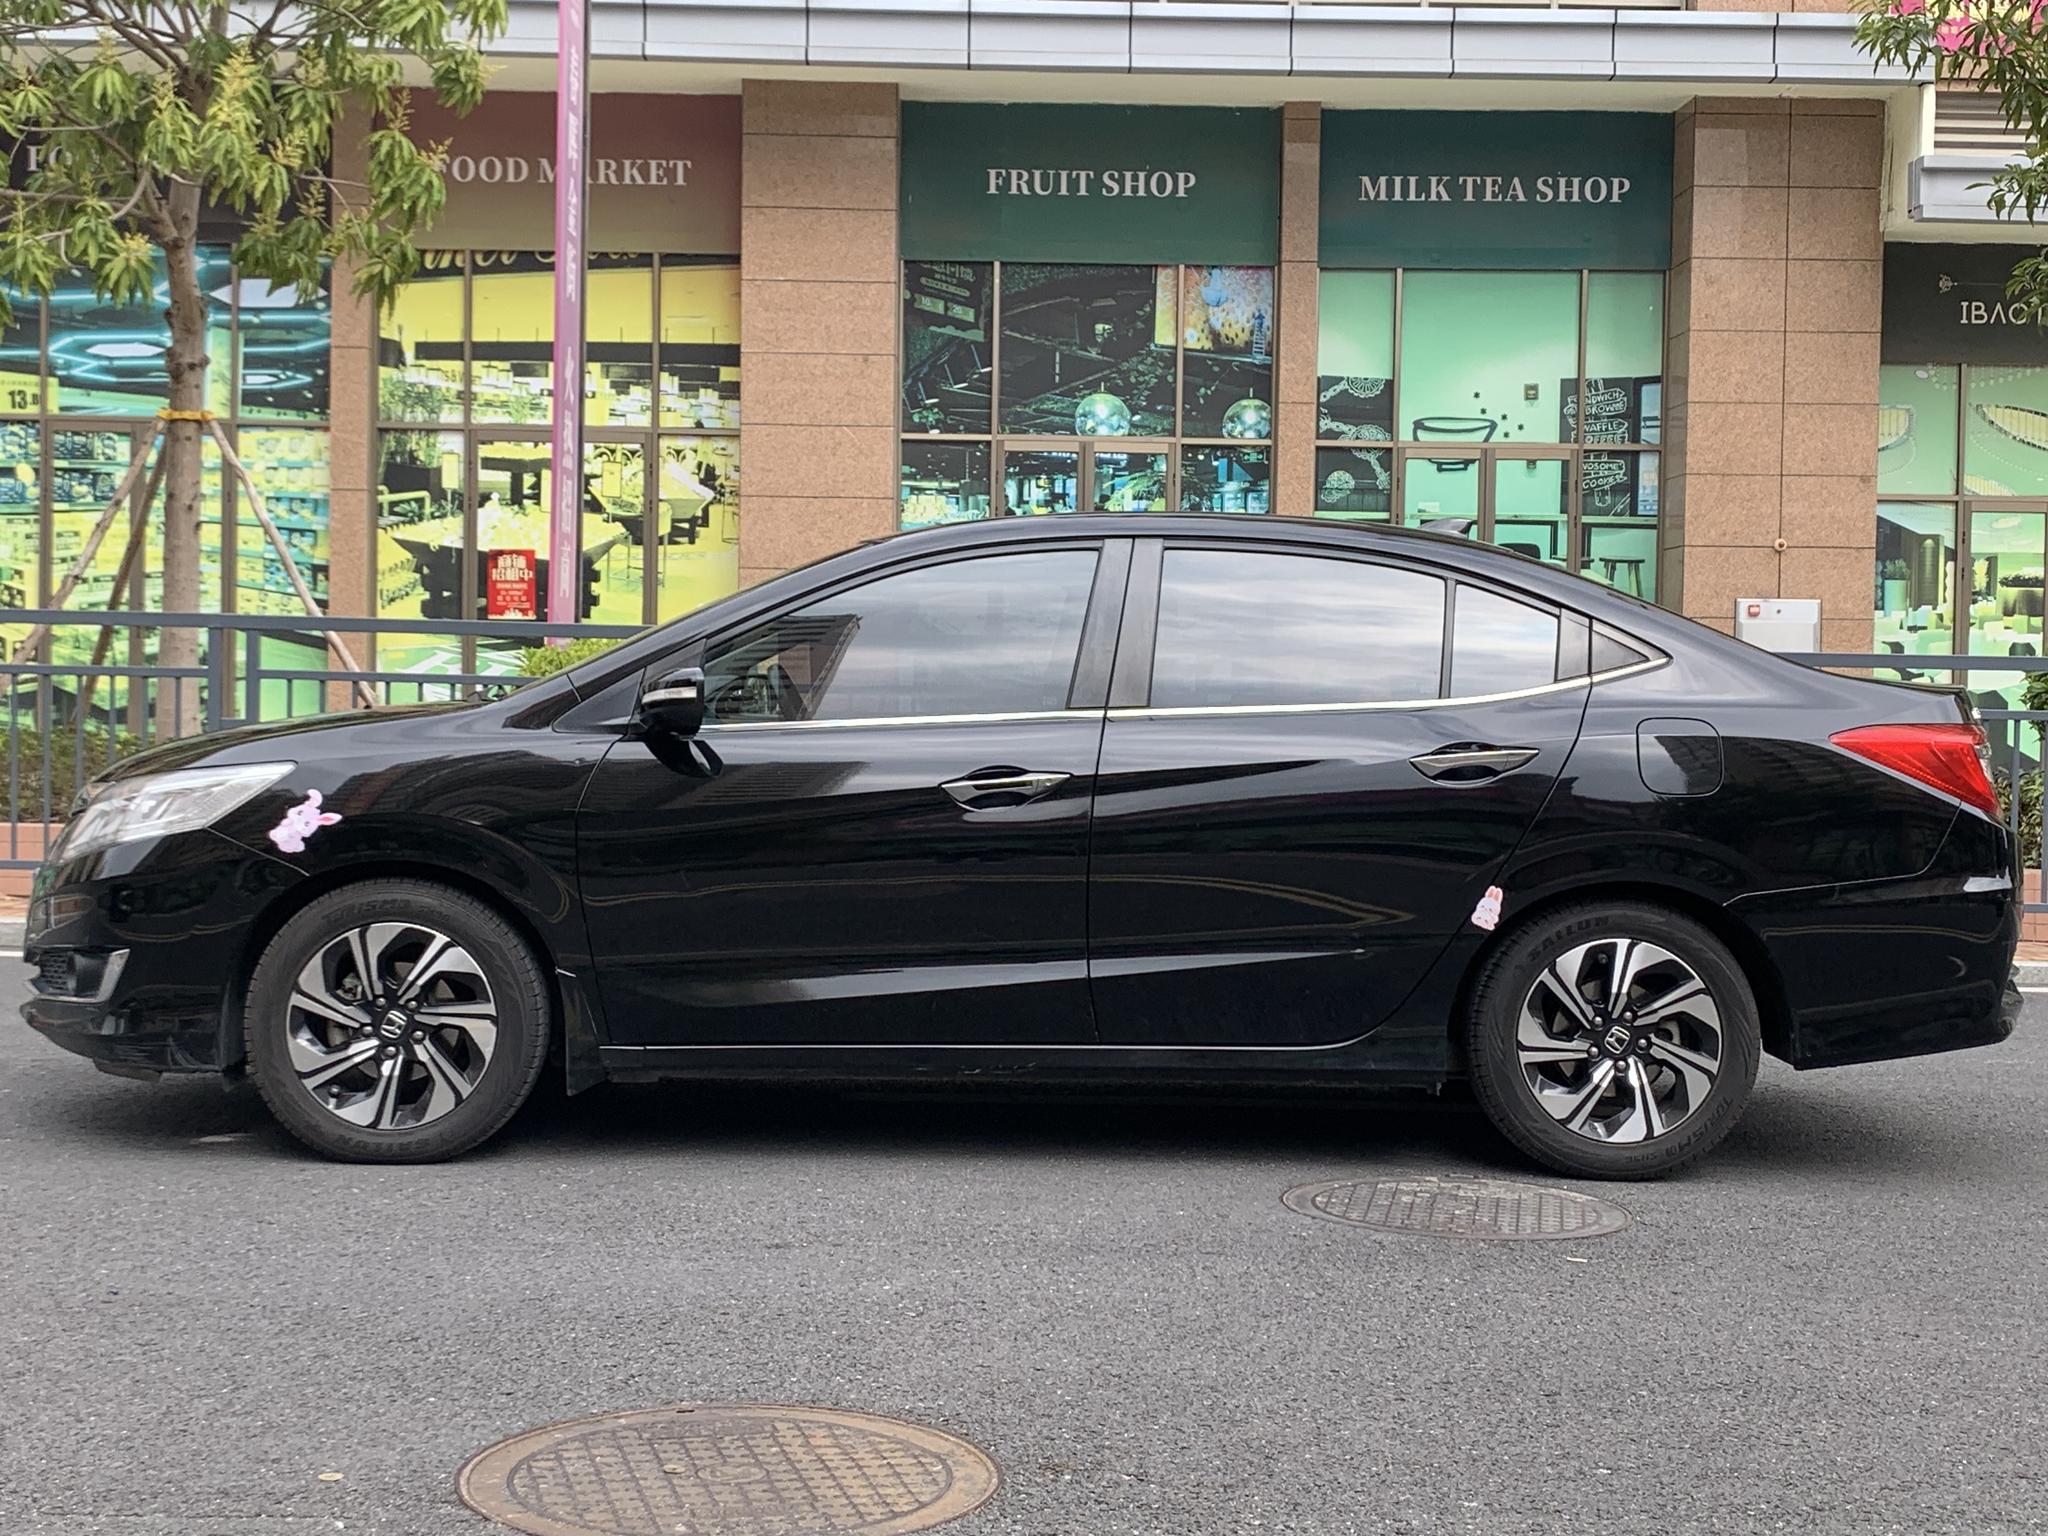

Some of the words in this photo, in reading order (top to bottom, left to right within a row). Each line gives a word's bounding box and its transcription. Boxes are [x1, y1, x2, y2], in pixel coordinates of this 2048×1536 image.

[441, 155, 529, 184] OOD
[537, 157, 692, 186] MRKET
[986, 168, 1094, 196] FRUIT
[1102, 170, 1196, 198] SHOP
[1358, 175, 1452, 202] MILK
[1459, 175, 1528, 202] TEA
[1536, 176, 1631, 203] SHOP
